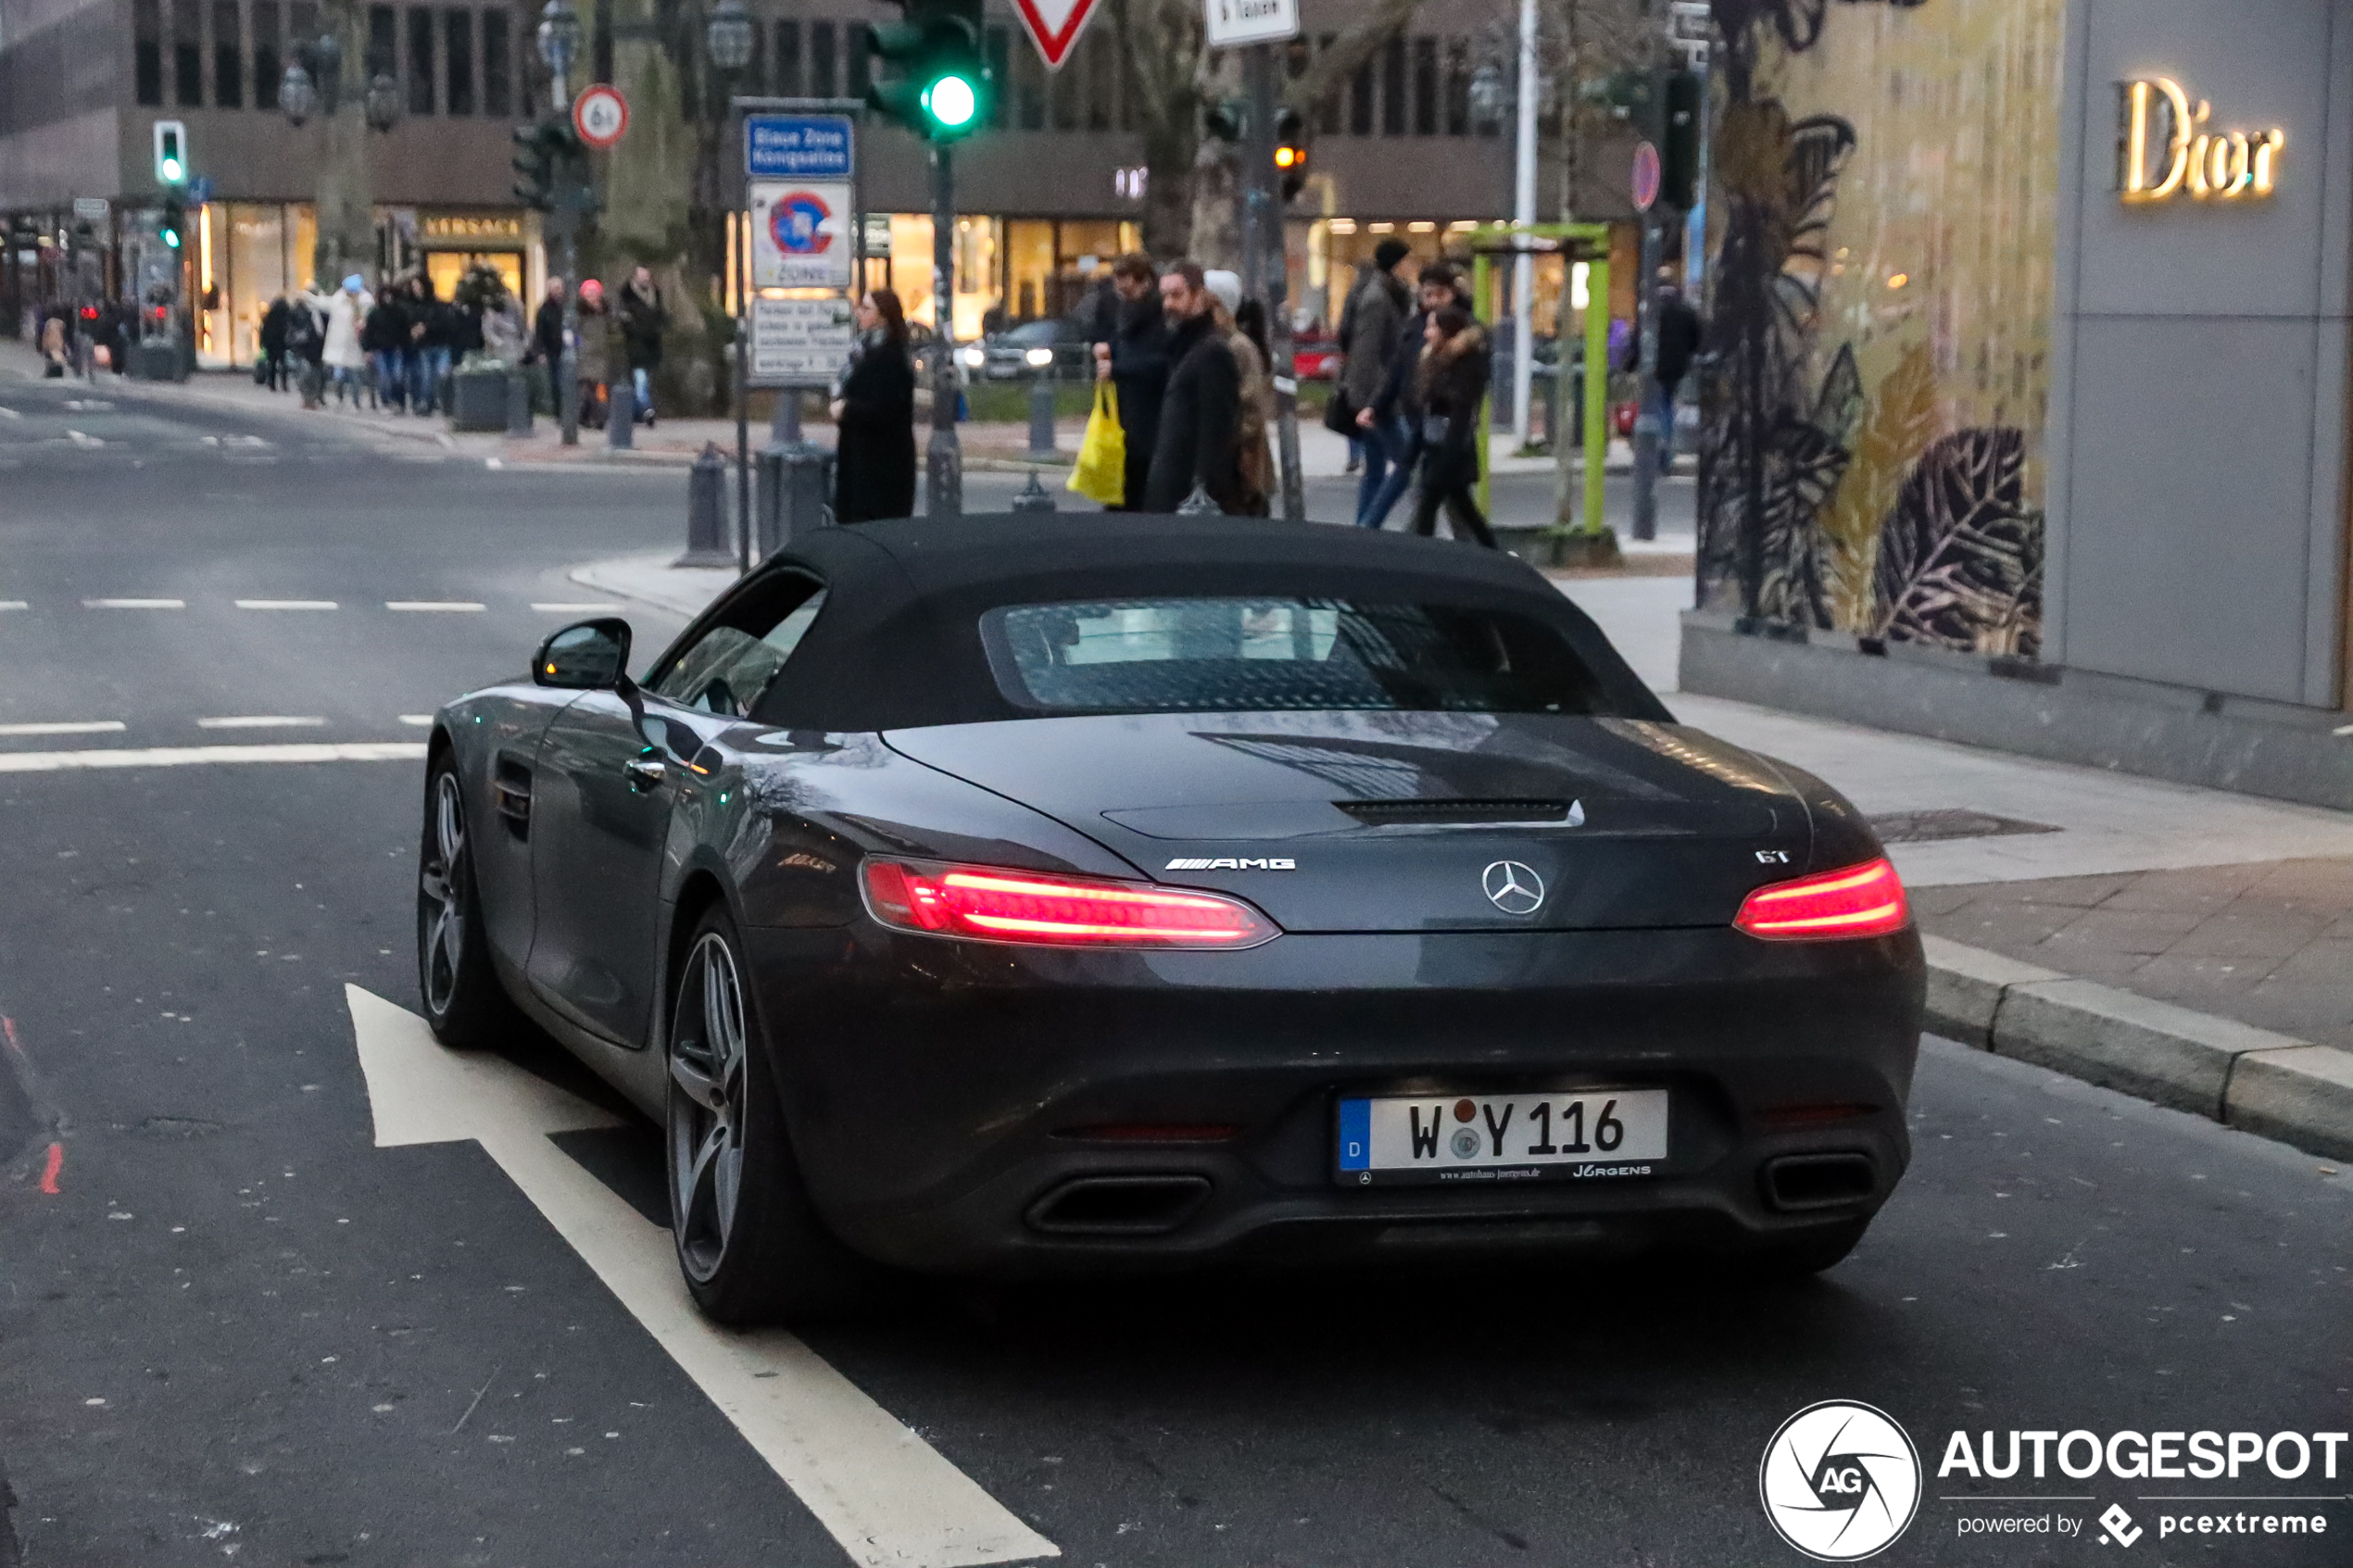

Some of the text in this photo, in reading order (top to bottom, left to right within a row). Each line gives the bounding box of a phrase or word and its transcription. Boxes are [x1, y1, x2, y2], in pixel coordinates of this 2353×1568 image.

[803, 127, 844, 147] Zone
[2116, 77, 2284, 200] Dior
[426, 218, 520, 235] VERSACE
[779, 263, 827, 282] ZONE
[1410, 1099, 1623, 1160] W Y 116
[1349, 1141, 1361, 1158] D
